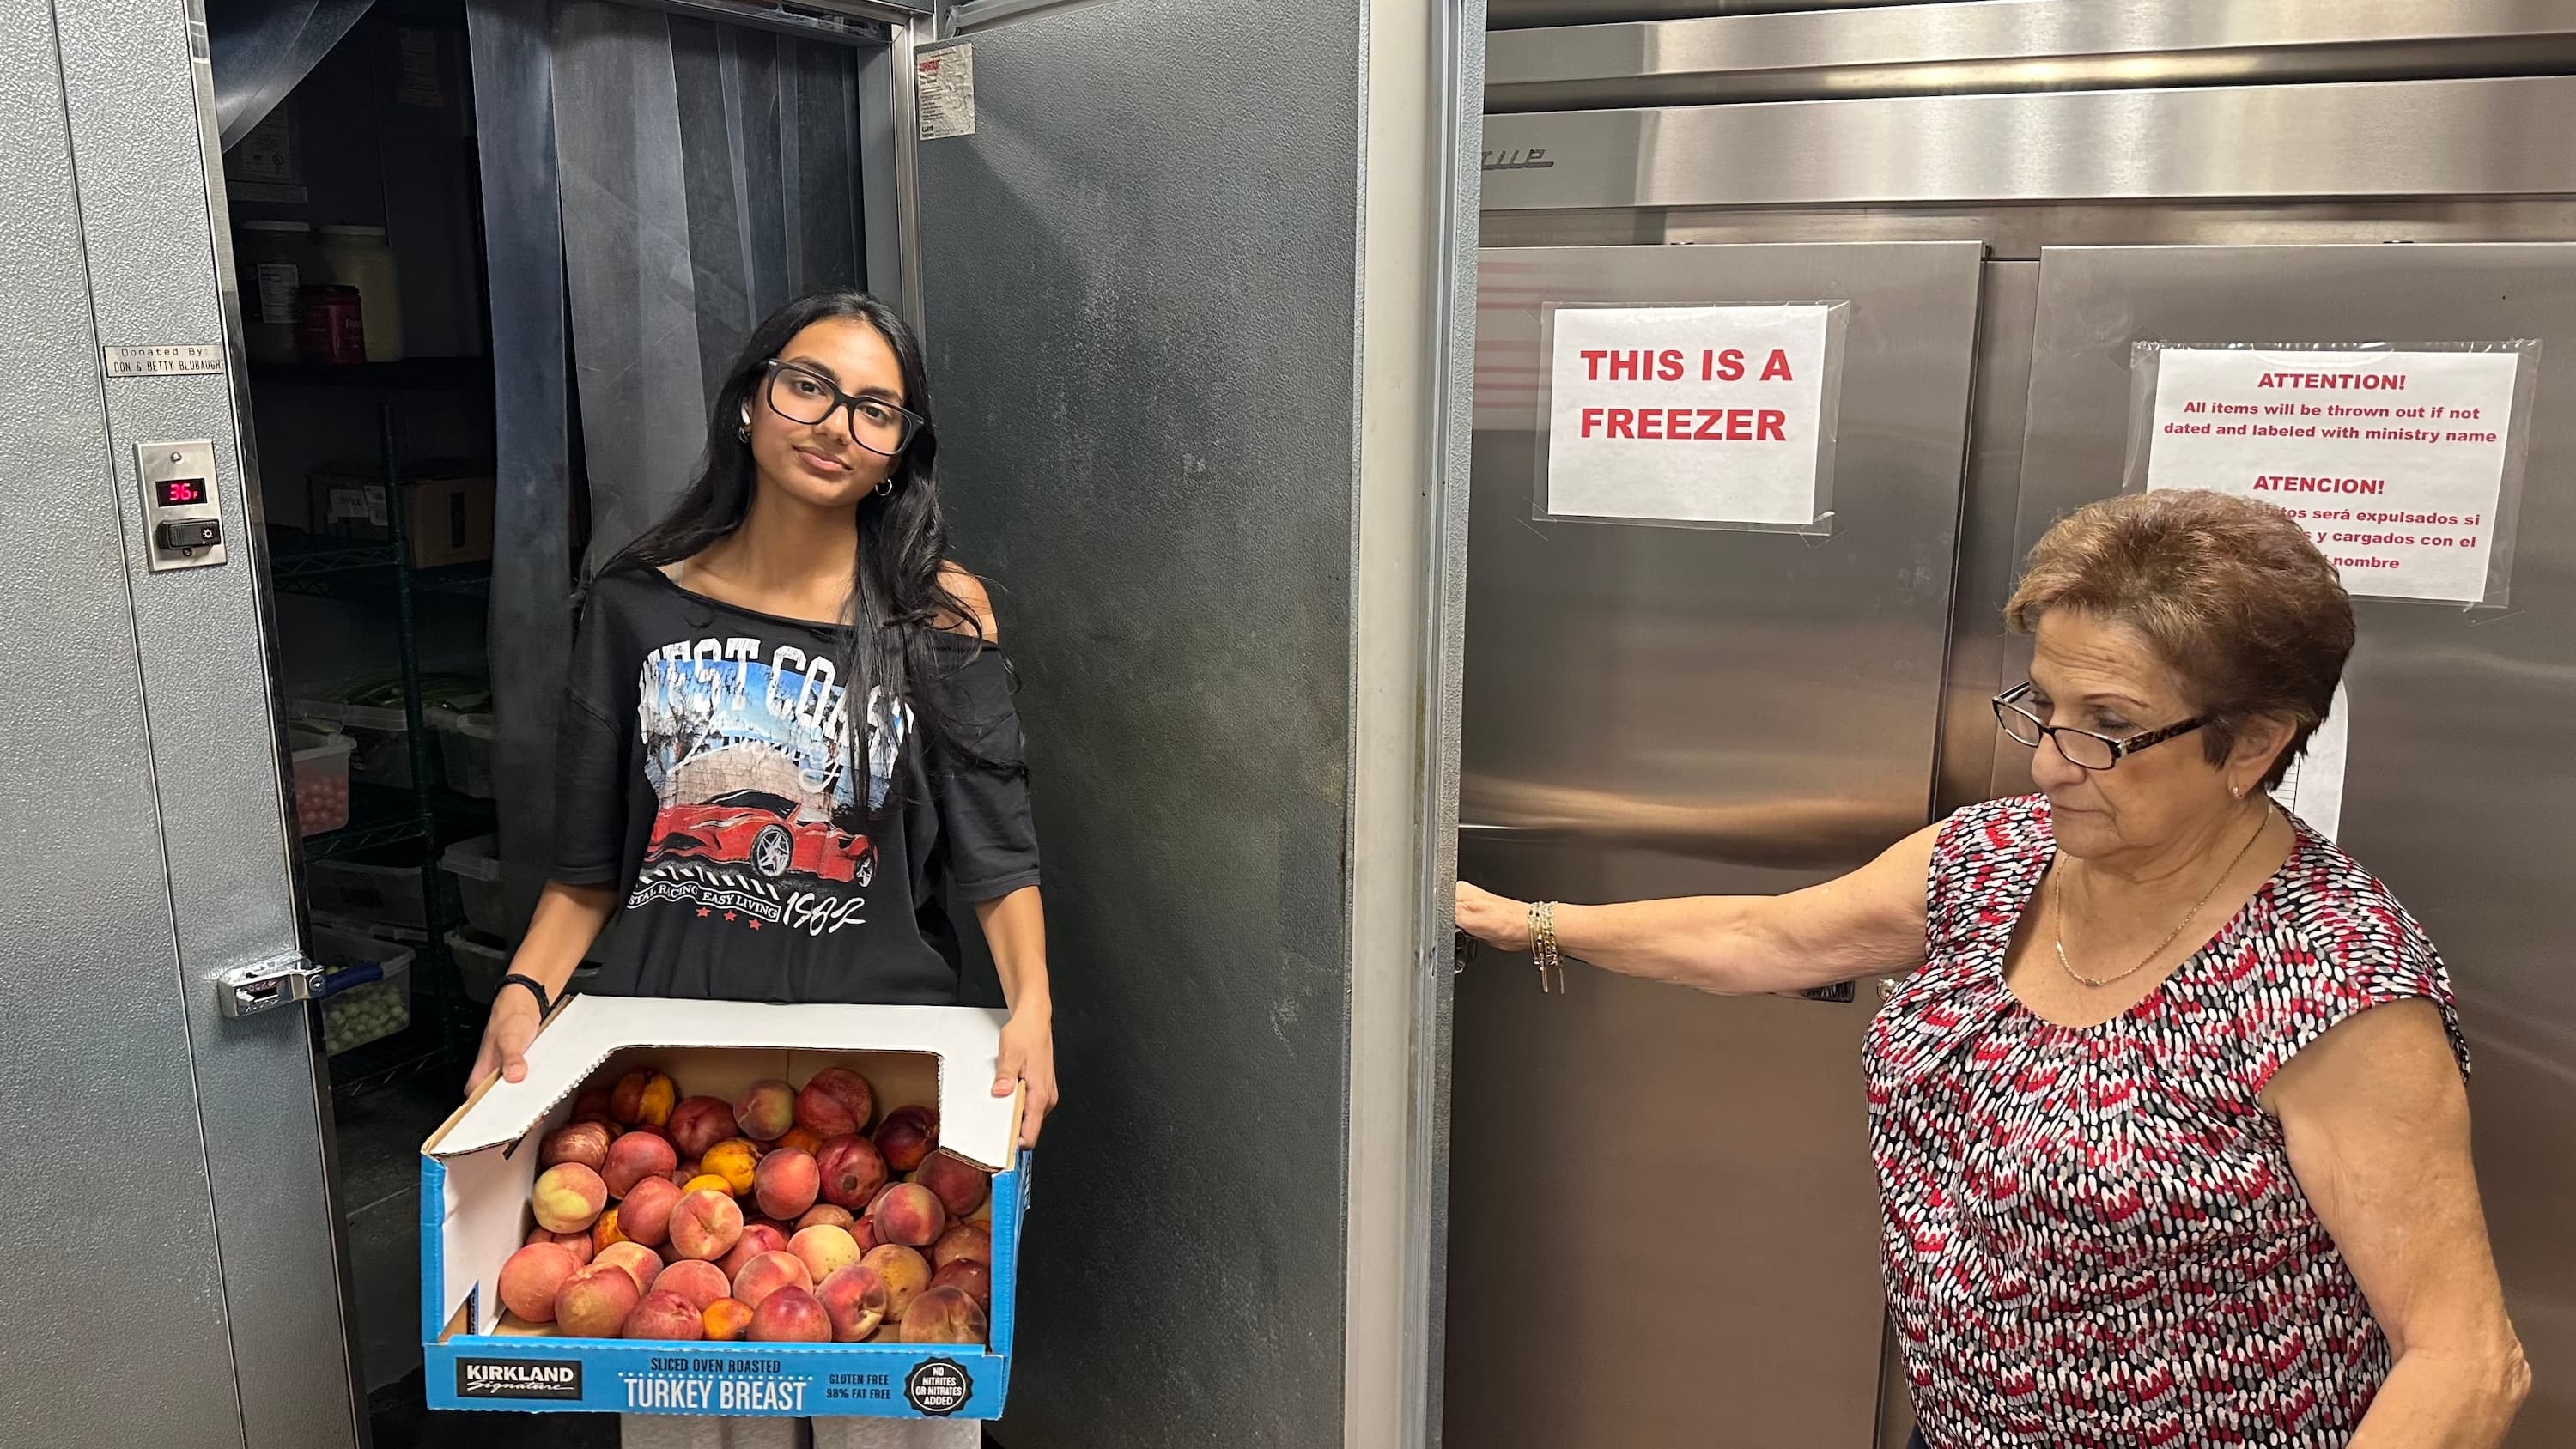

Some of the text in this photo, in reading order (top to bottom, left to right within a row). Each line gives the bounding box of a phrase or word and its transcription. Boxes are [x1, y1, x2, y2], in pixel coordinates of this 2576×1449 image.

[121, 348, 179, 357] Donated
[113, 361, 131, 373] DON
[147, 361, 172, 372] BETTY
[179, 359, 221, 371] BLUBAUGH
[1580, 349, 1793, 381] THIS IS A
[2257, 373, 2406, 390] ATTENTION!
[2184, 402, 2480, 419] All items will be thrown out if not
[1580, 408, 1787, 441] FREEZER
[2164, 422, 2497, 443] dated and labeled with ministry name
[2252, 476, 2385, 494] ATENCION!
[2281, 506, 2480, 526] tos será expulsados si
[2317, 531, 2327, 543] y
[2332, 532, 2415, 545] cargados
[2421, 536, 2453, 547] con
[2459, 537, 2476, 548] el
[2334, 556, 2400, 569] nombre
[629, 888, 656, 905] STAL
[702, 892, 732, 905] EASY
[736, 897, 778, 919] LIVING
[466, 1365, 574, 1382] KIRKLAND
[651, 1358, 781, 1373] SLICED OVEN ROASTED
[933, 1367, 945, 1376] NO
[466, 1379, 574, 1394] Signature
[829, 1373, 889, 1385] GLUTEN FREE
[922, 1377, 957, 1386] NITRITES
[624, 1379, 807, 1410] TURKEY BREAST
[826, 1389, 890, 1399] 98% FAT FREE
[915, 1386, 963, 1397] OR NITRATES
[923, 1396, 953, 1406] ADDED
